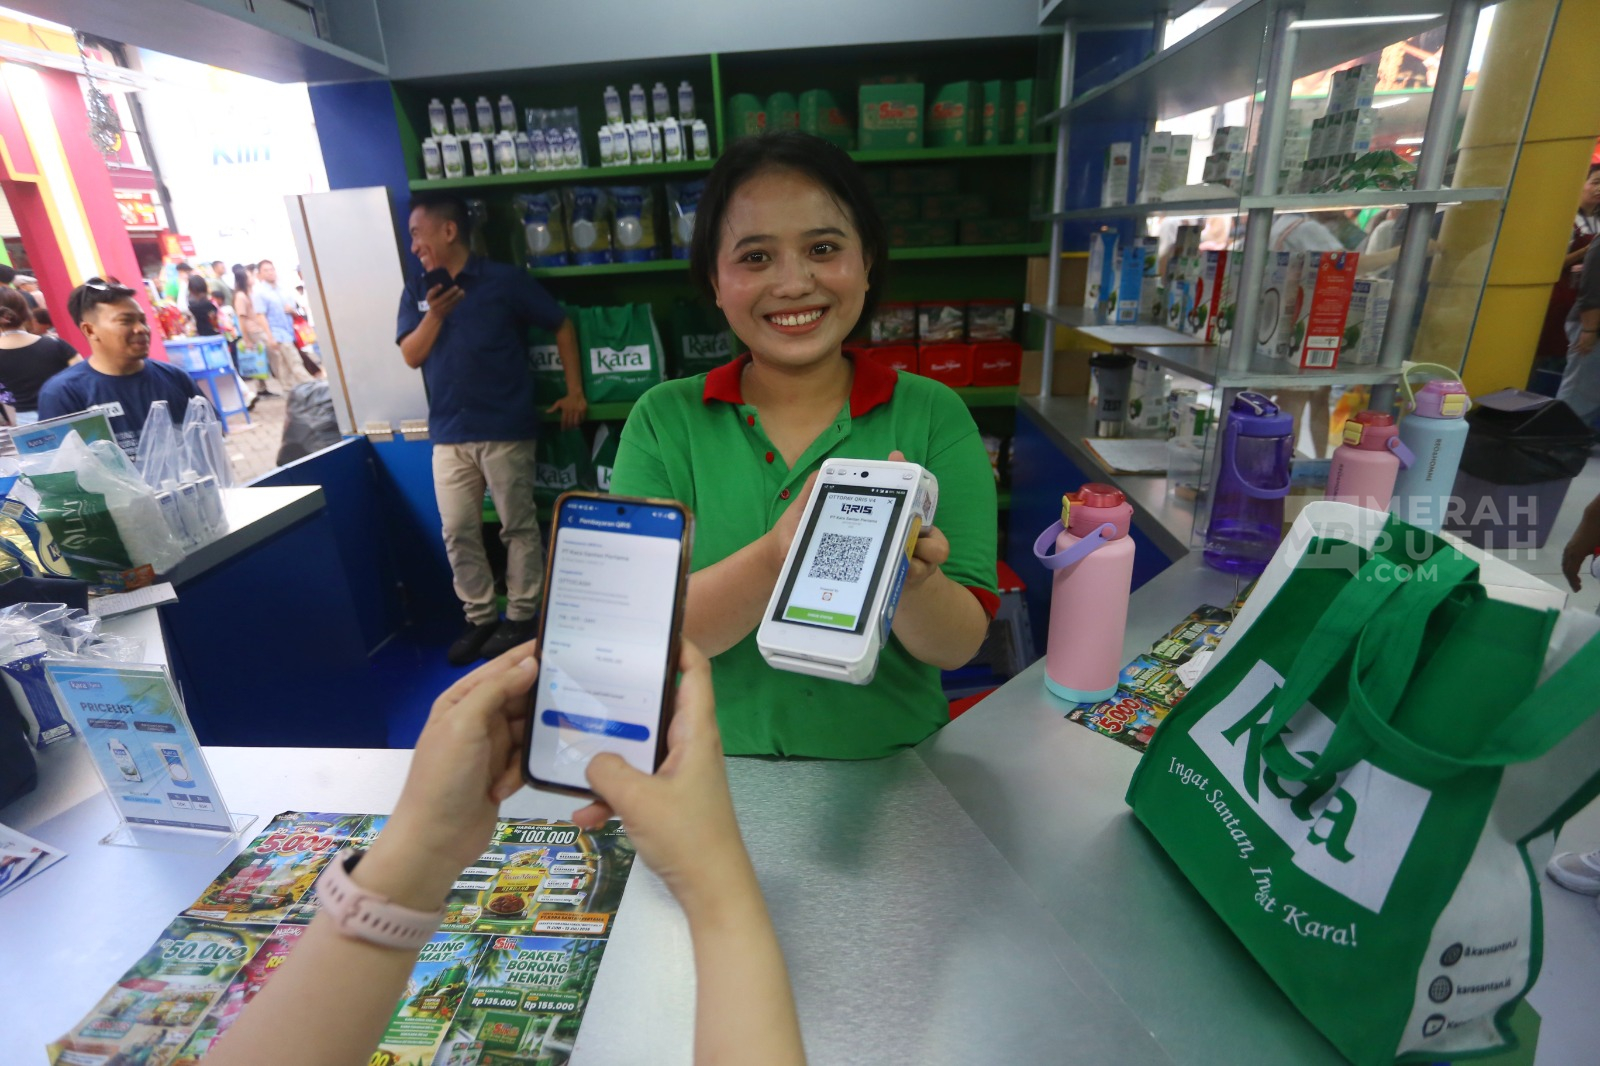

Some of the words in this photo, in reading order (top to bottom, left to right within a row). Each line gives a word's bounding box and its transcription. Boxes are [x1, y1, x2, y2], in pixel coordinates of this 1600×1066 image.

[597, 350, 643, 371] kara
[841, 502, 873, 514] QRIS
[80, 702, 134, 714] PRICELIST
[1098, 698, 1141, 734] 5.000
[255, 834, 335, 854] 5.000
[520, 830, 575, 844] 100.000
[1168, 756, 1210, 791] Ingat
[1205, 789, 1255, 860] Santan,
[1283, 904, 1358, 947] Kara!
[420, 940, 465, 952] DLING
[517, 950, 566, 962] PAKET
[506, 960, 570, 974] BORONG
[507, 971, 564, 986] HEMAT!
[471, 997, 484, 1006] Rp
[484, 998, 517, 1007] 135.000
[523, 1001, 537, 1011] Rp
[537, 1001, 575, 1011] 155.000
